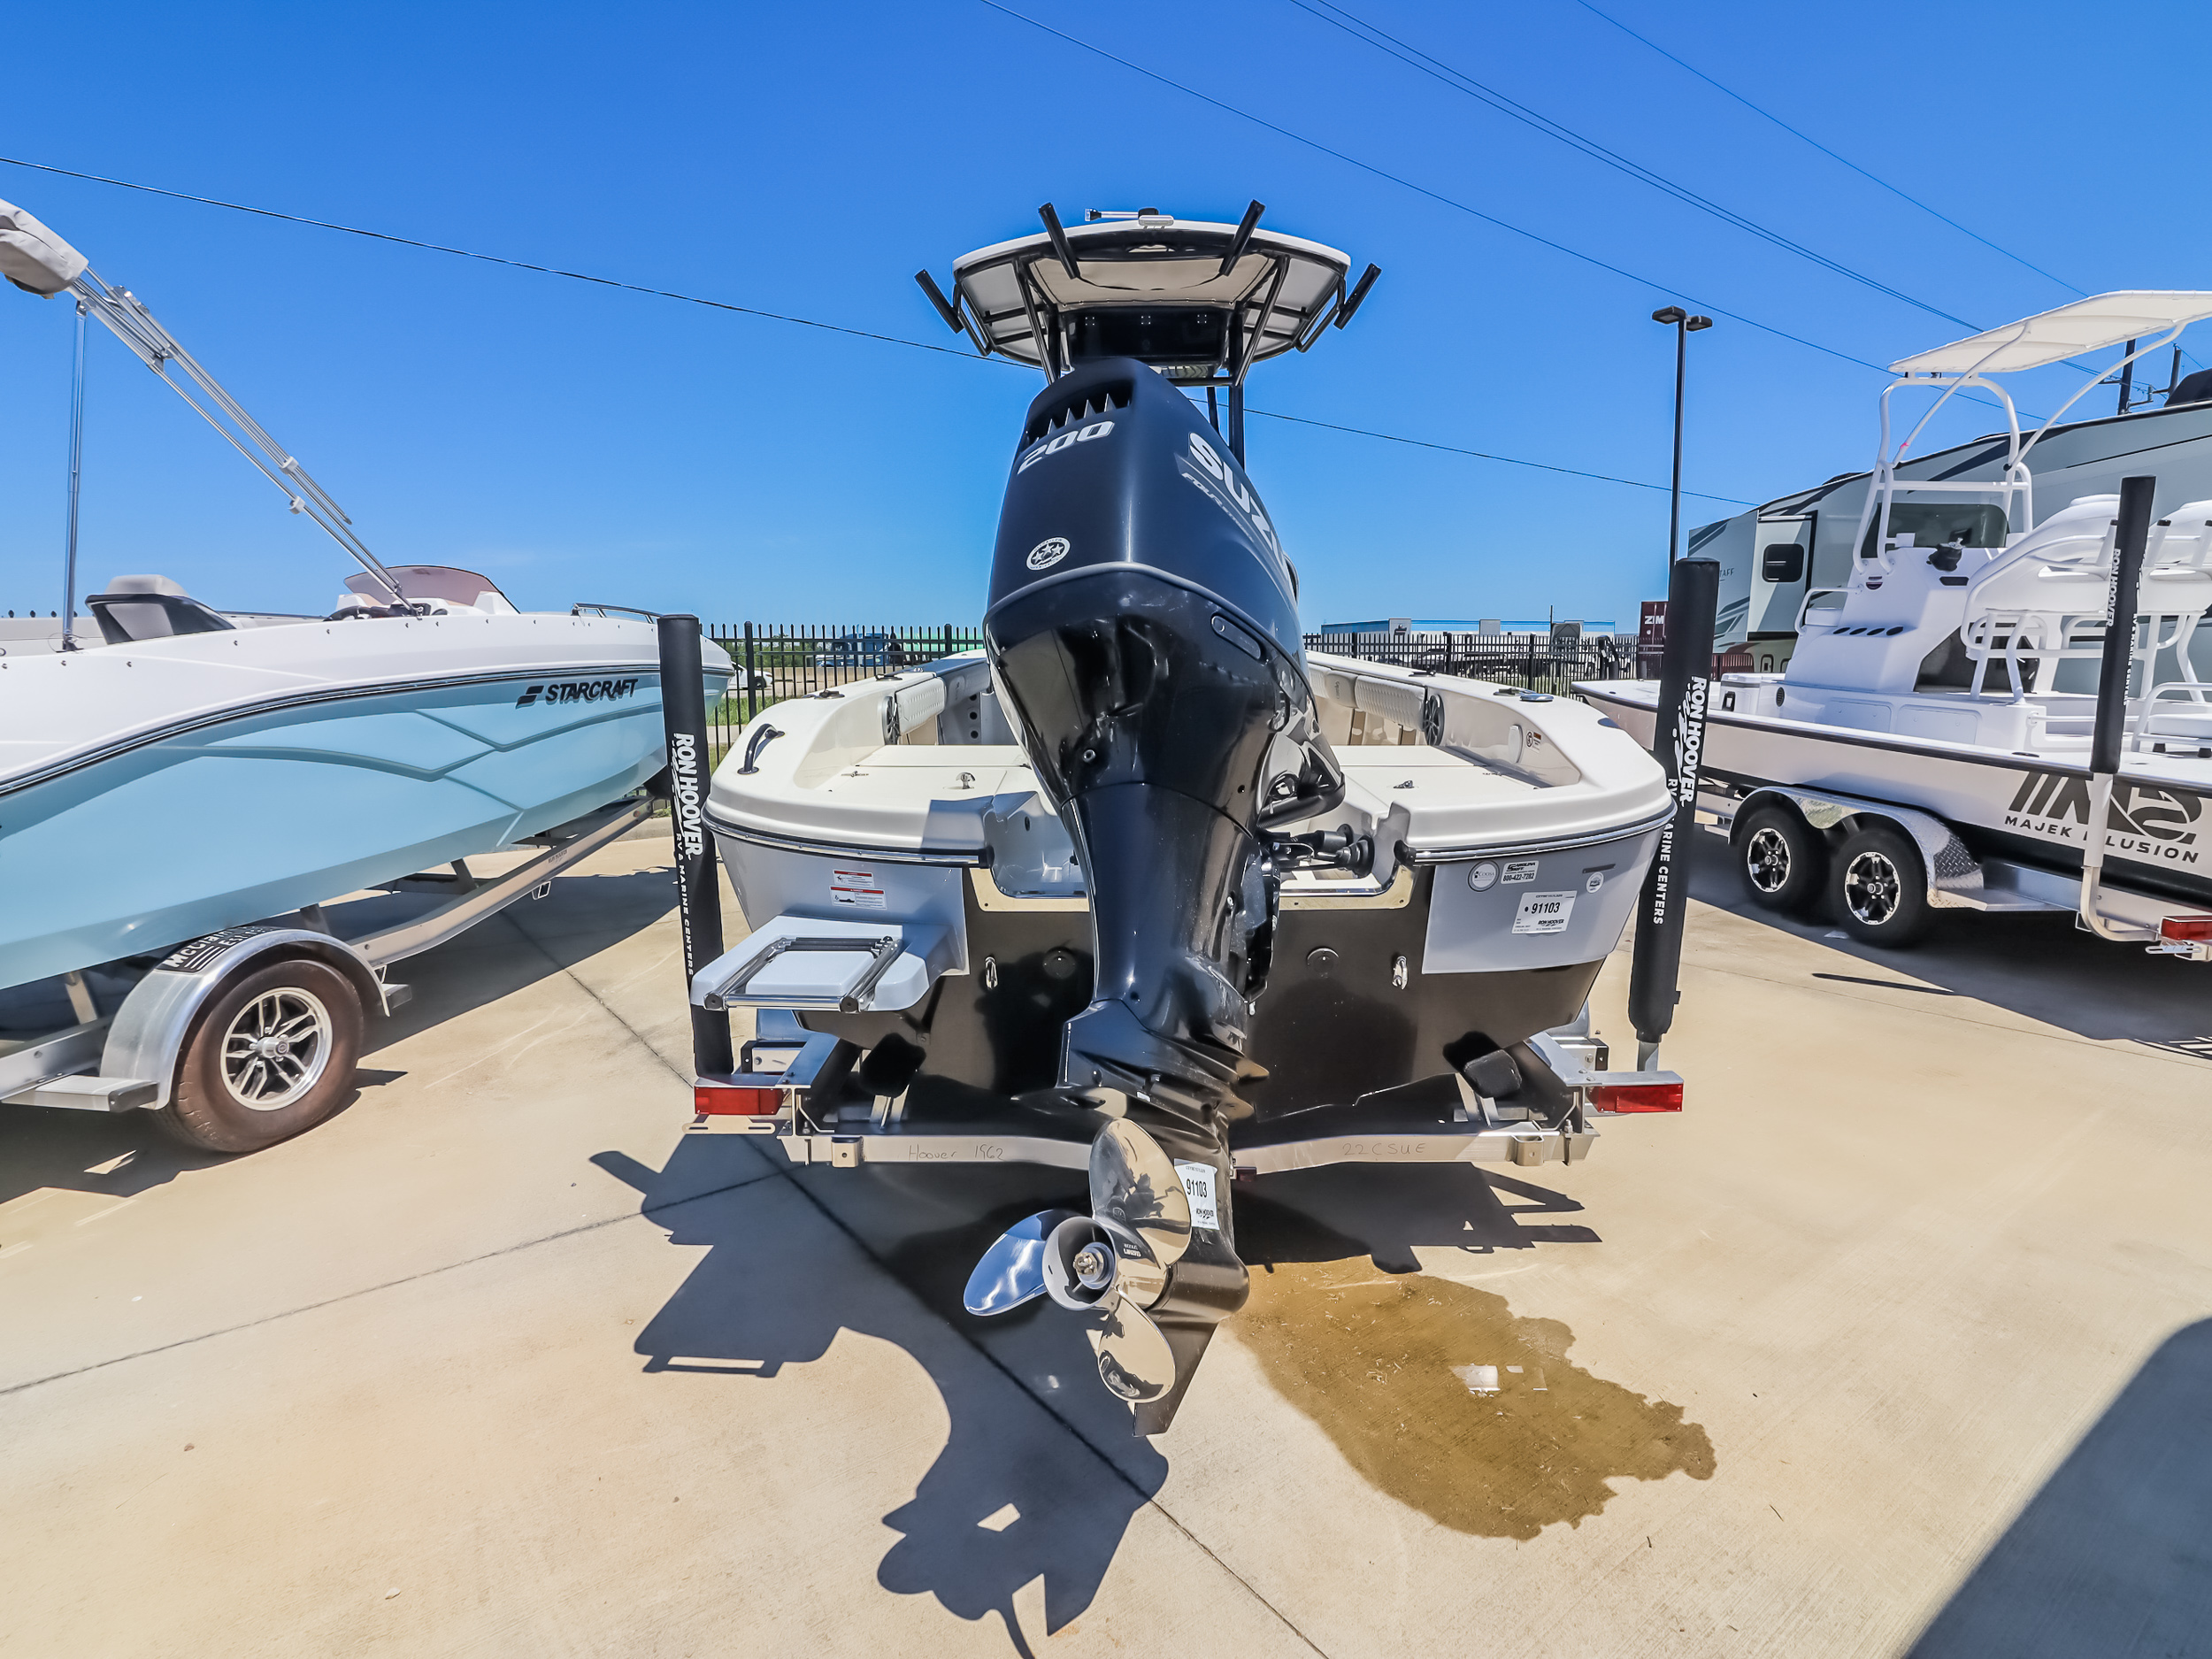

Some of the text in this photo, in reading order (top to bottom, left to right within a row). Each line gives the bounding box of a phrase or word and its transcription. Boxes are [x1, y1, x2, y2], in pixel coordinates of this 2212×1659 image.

[1018, 420, 1115, 474] 200
[1189, 432, 1290, 584] SUZU
[2106, 548, 2121, 627] RON HOOVER
[1644, 615, 1665, 625] ZIM
[545, 679, 639, 704] STARCRAFT
[1679, 675, 1708, 807] RON HOOVER
[674, 733, 703, 861] RON HOOVER
[1653, 778, 1678, 925] RV ARINE CENTERS
[2004, 815, 2199, 863] MAJEK ILUSION
[675, 833, 683, 850] RV
[679, 864, 689, 915] MARINE
[684, 918, 694, 976] CENTERS
[1531, 902, 1561, 914] 91103
[909, 1144, 1004, 1161] Hoover 1962
[1186, 1179, 1208, 1198] 91103
